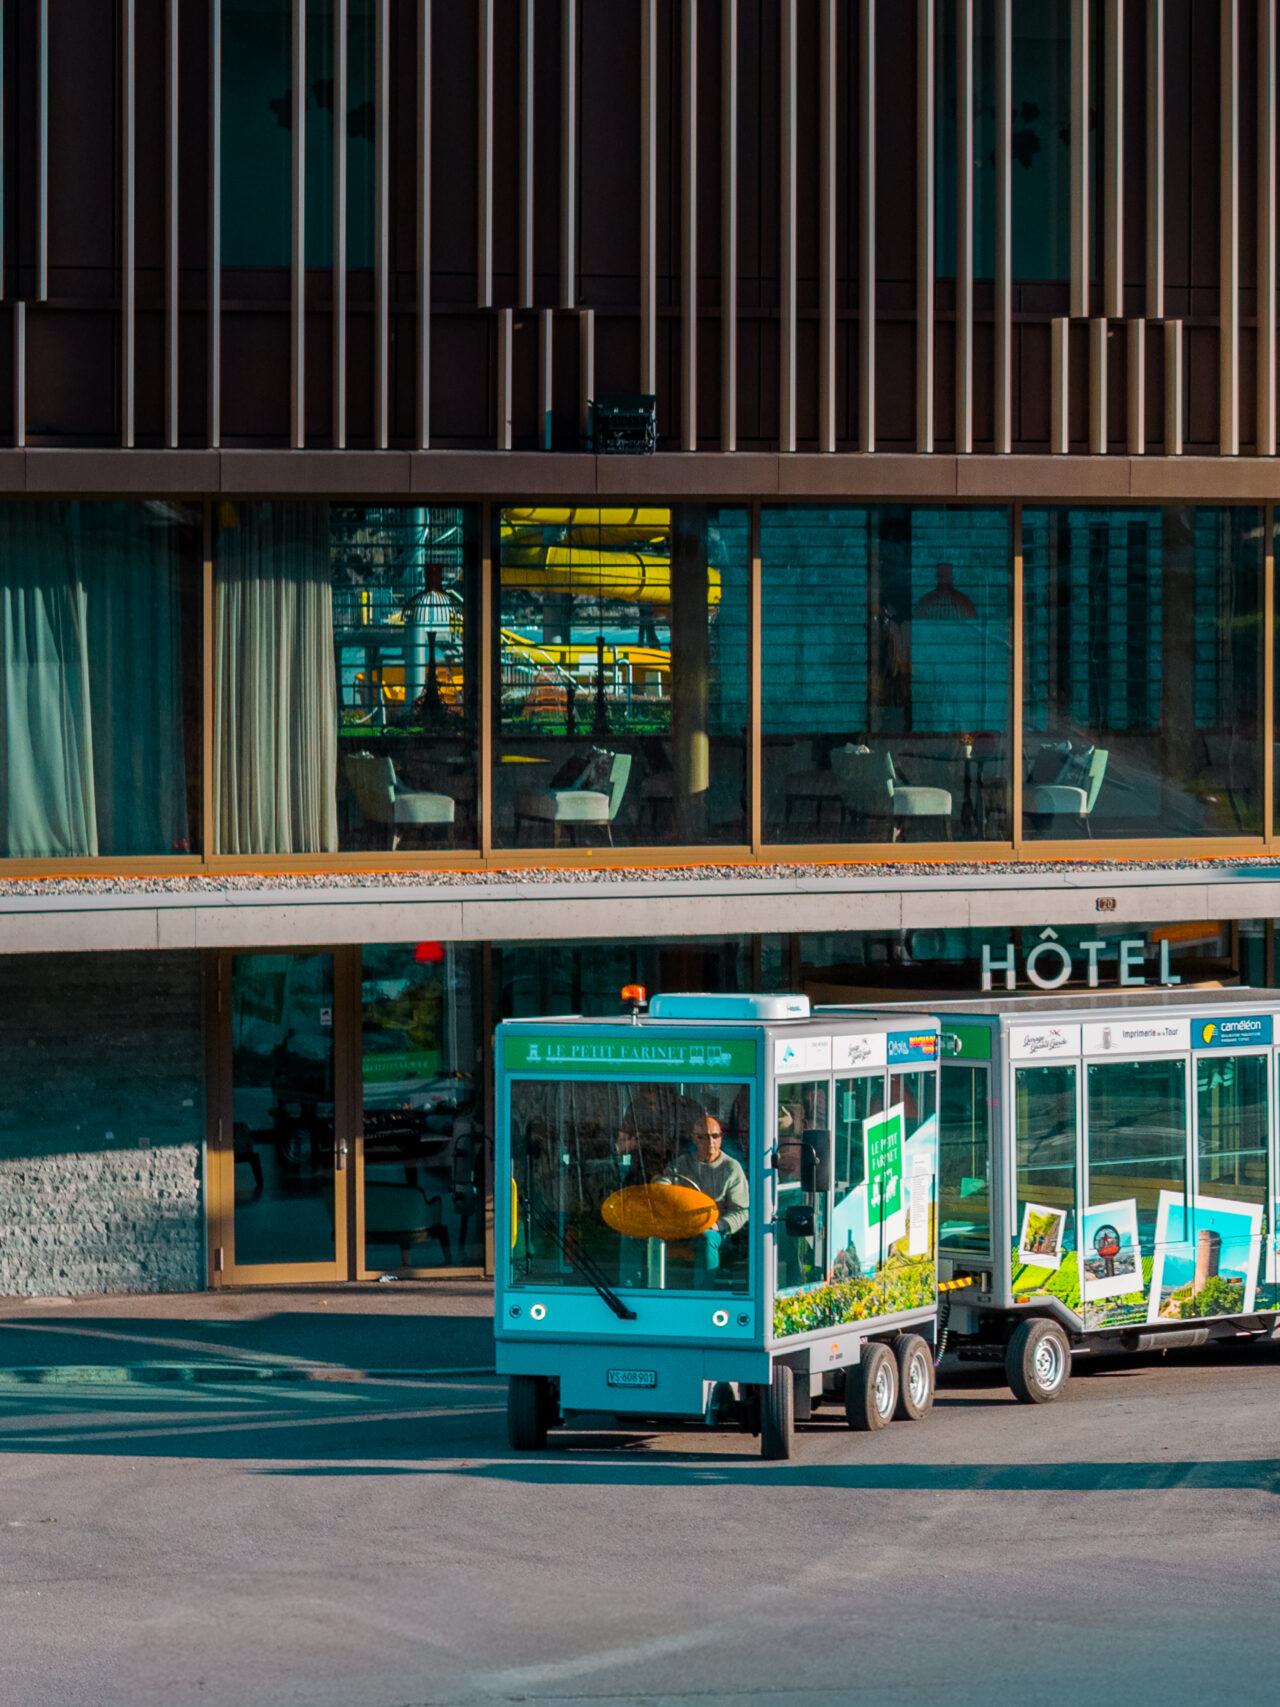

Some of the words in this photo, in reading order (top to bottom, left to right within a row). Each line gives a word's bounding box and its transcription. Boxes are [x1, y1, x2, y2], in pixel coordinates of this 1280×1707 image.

[1101, 899, 1114, 909] 20
[982, 926, 1181, 991] HÔTEL
[1220, 1020, 1262, 1032] caméléon
[1122, 1029, 1156, 1040] Imprimerie
[1165, 1027, 1179, 1037] Tour
[547, 1044, 566, 1057] LE
[572, 1045, 613, 1058] PETIT
[621, 1045, 686, 1060] FARINET
[871, 1141, 880, 1156] LE
